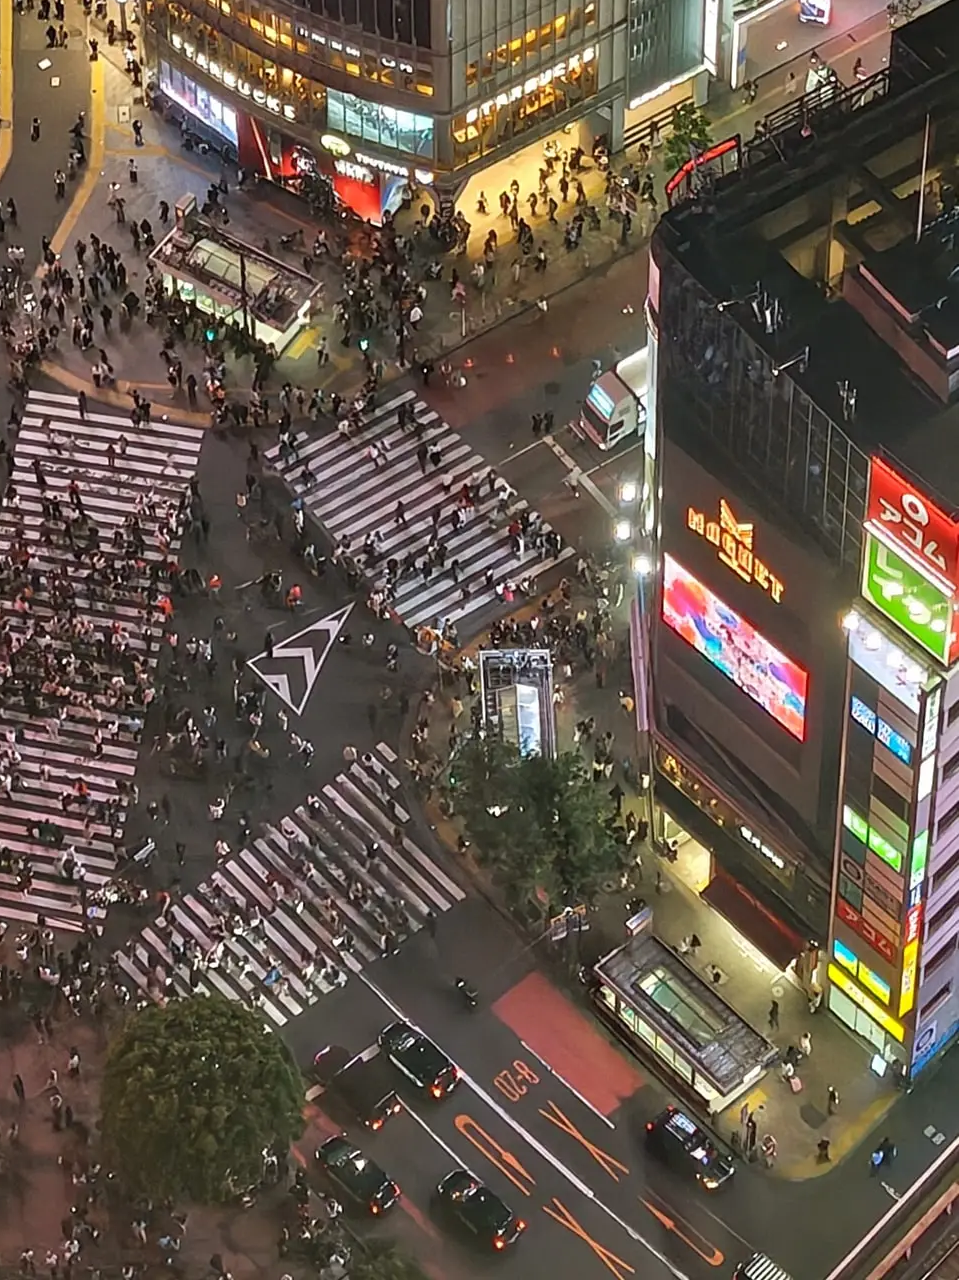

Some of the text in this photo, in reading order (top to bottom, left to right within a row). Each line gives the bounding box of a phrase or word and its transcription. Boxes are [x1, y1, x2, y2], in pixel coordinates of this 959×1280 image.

[169, 31, 297, 122] STARBUCKS
[879, 497, 948, 572] アコム
